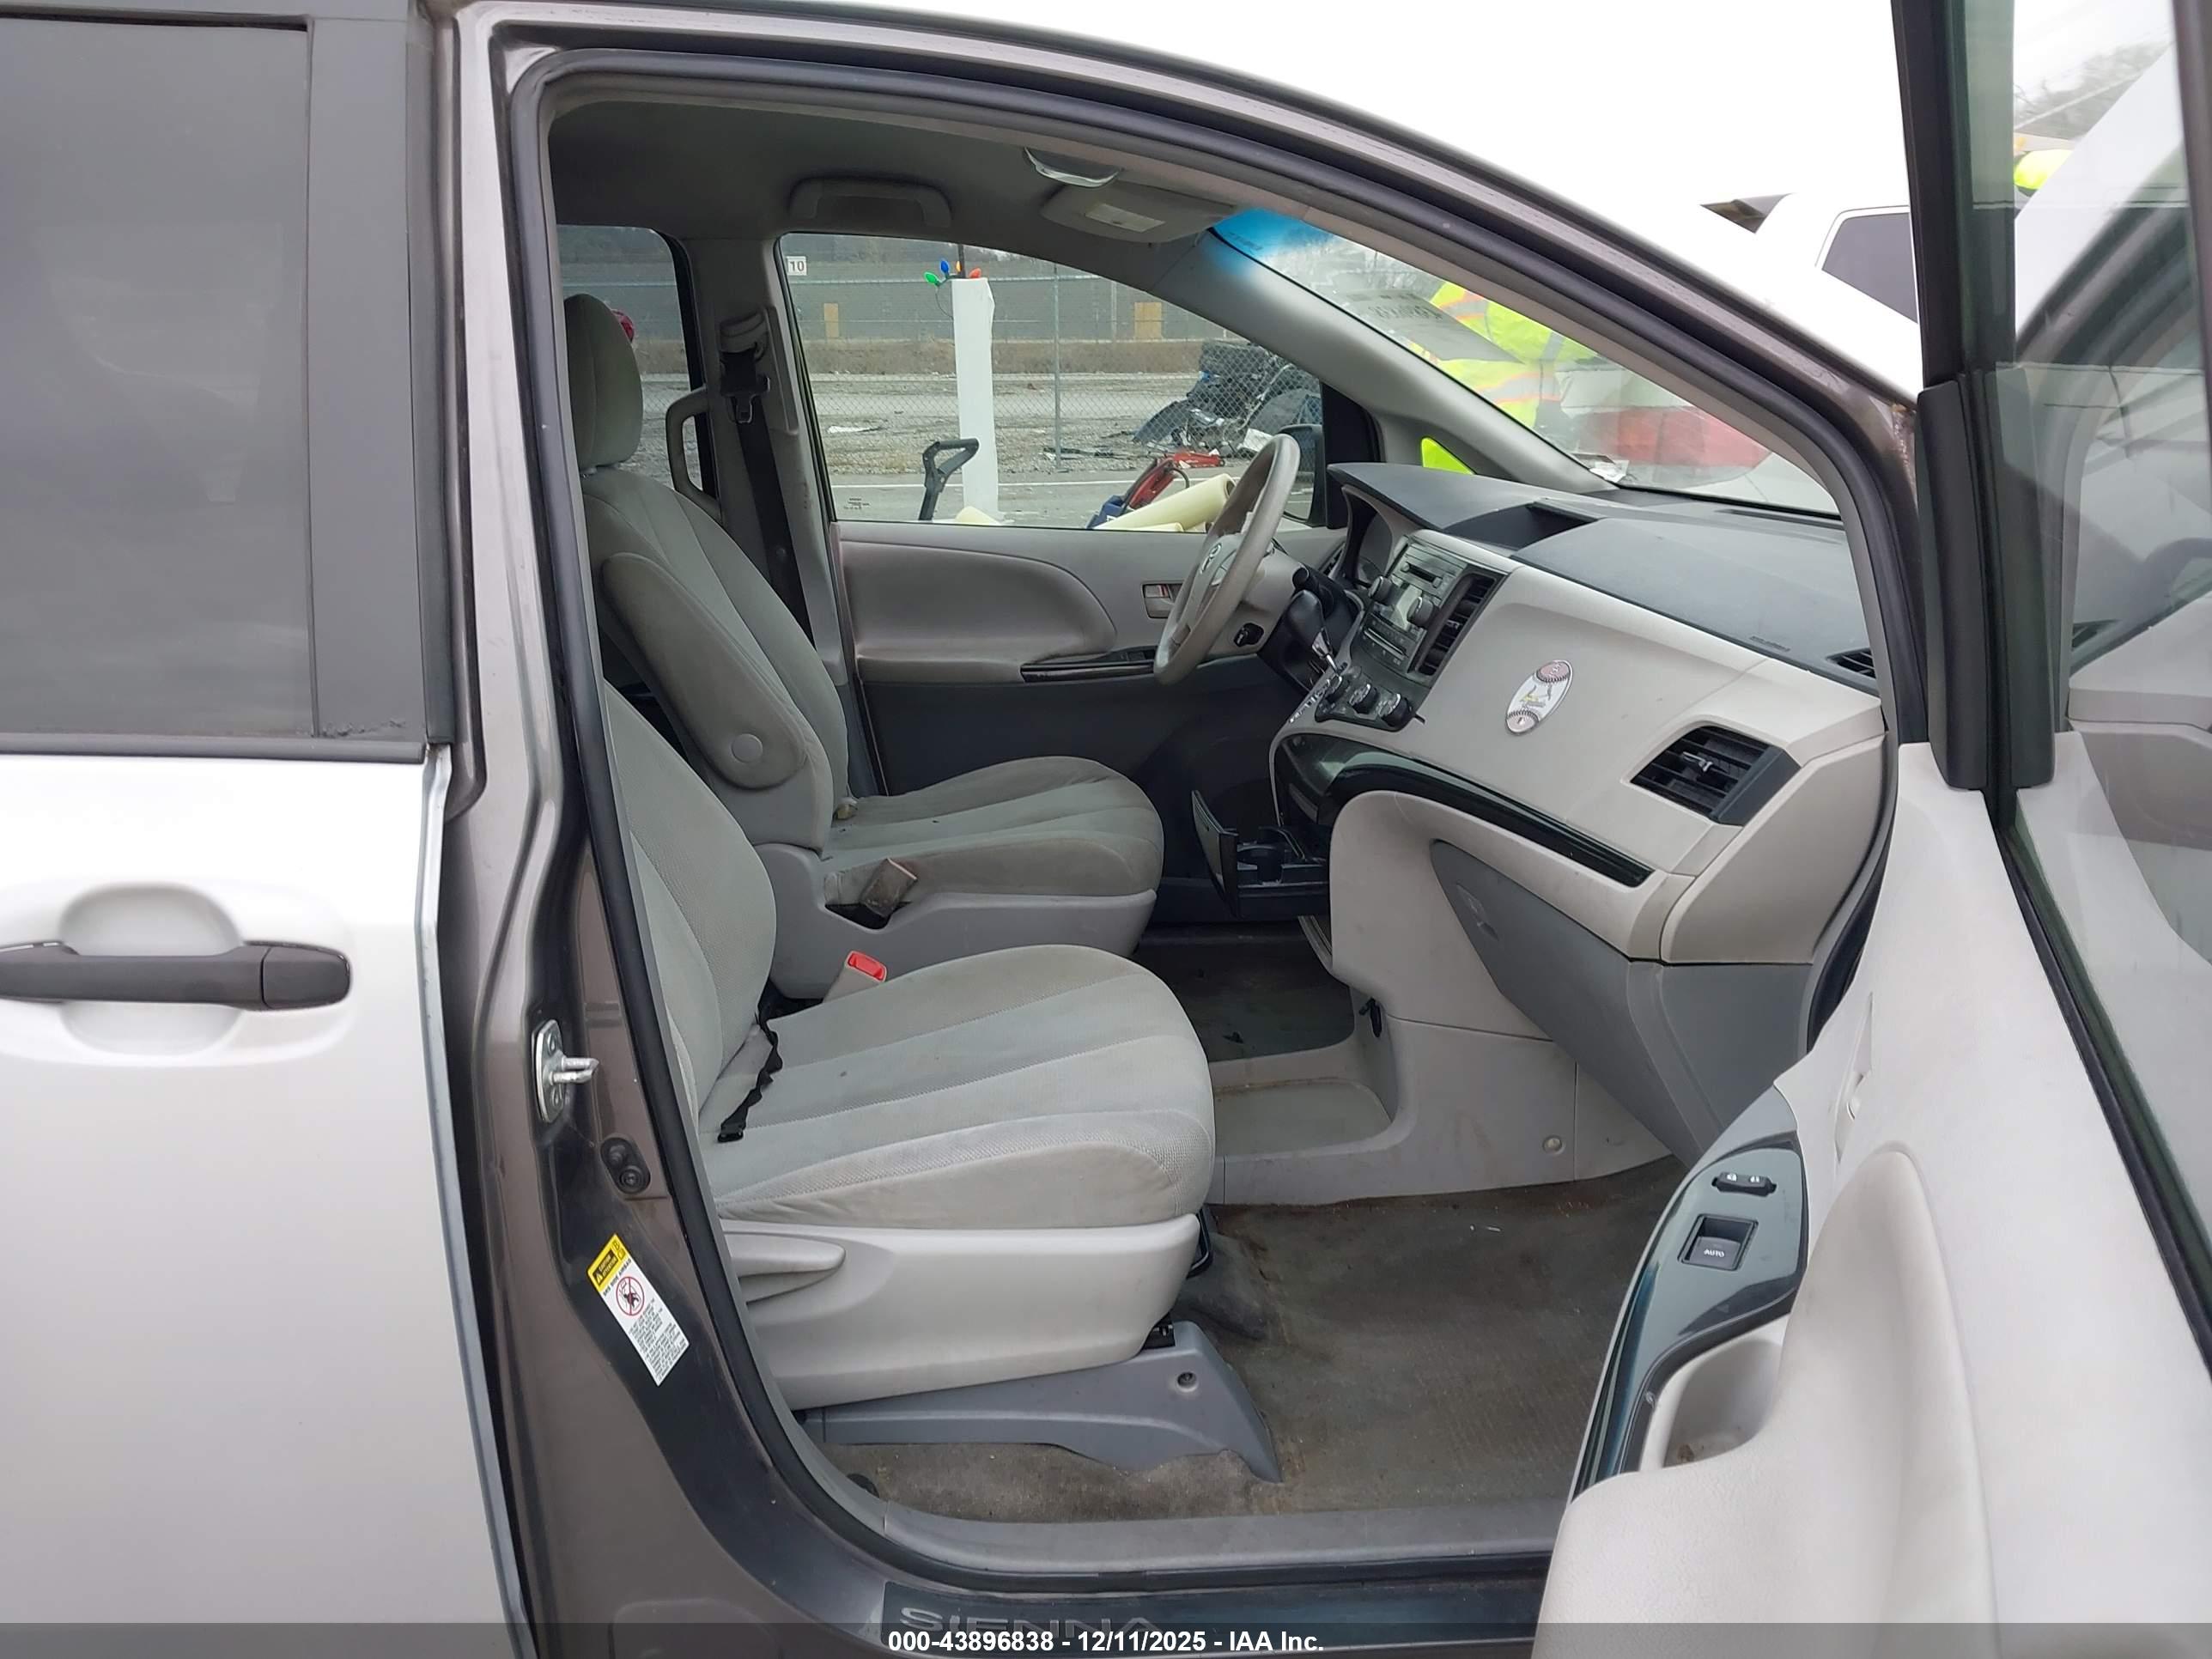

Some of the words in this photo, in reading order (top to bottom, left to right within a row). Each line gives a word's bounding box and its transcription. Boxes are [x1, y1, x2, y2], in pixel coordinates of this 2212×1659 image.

[790, 261, 805, 272] 10
[1704, 1249, 1725, 1258] AUTO
[900, 1607, 1165, 1638] SIENNA
